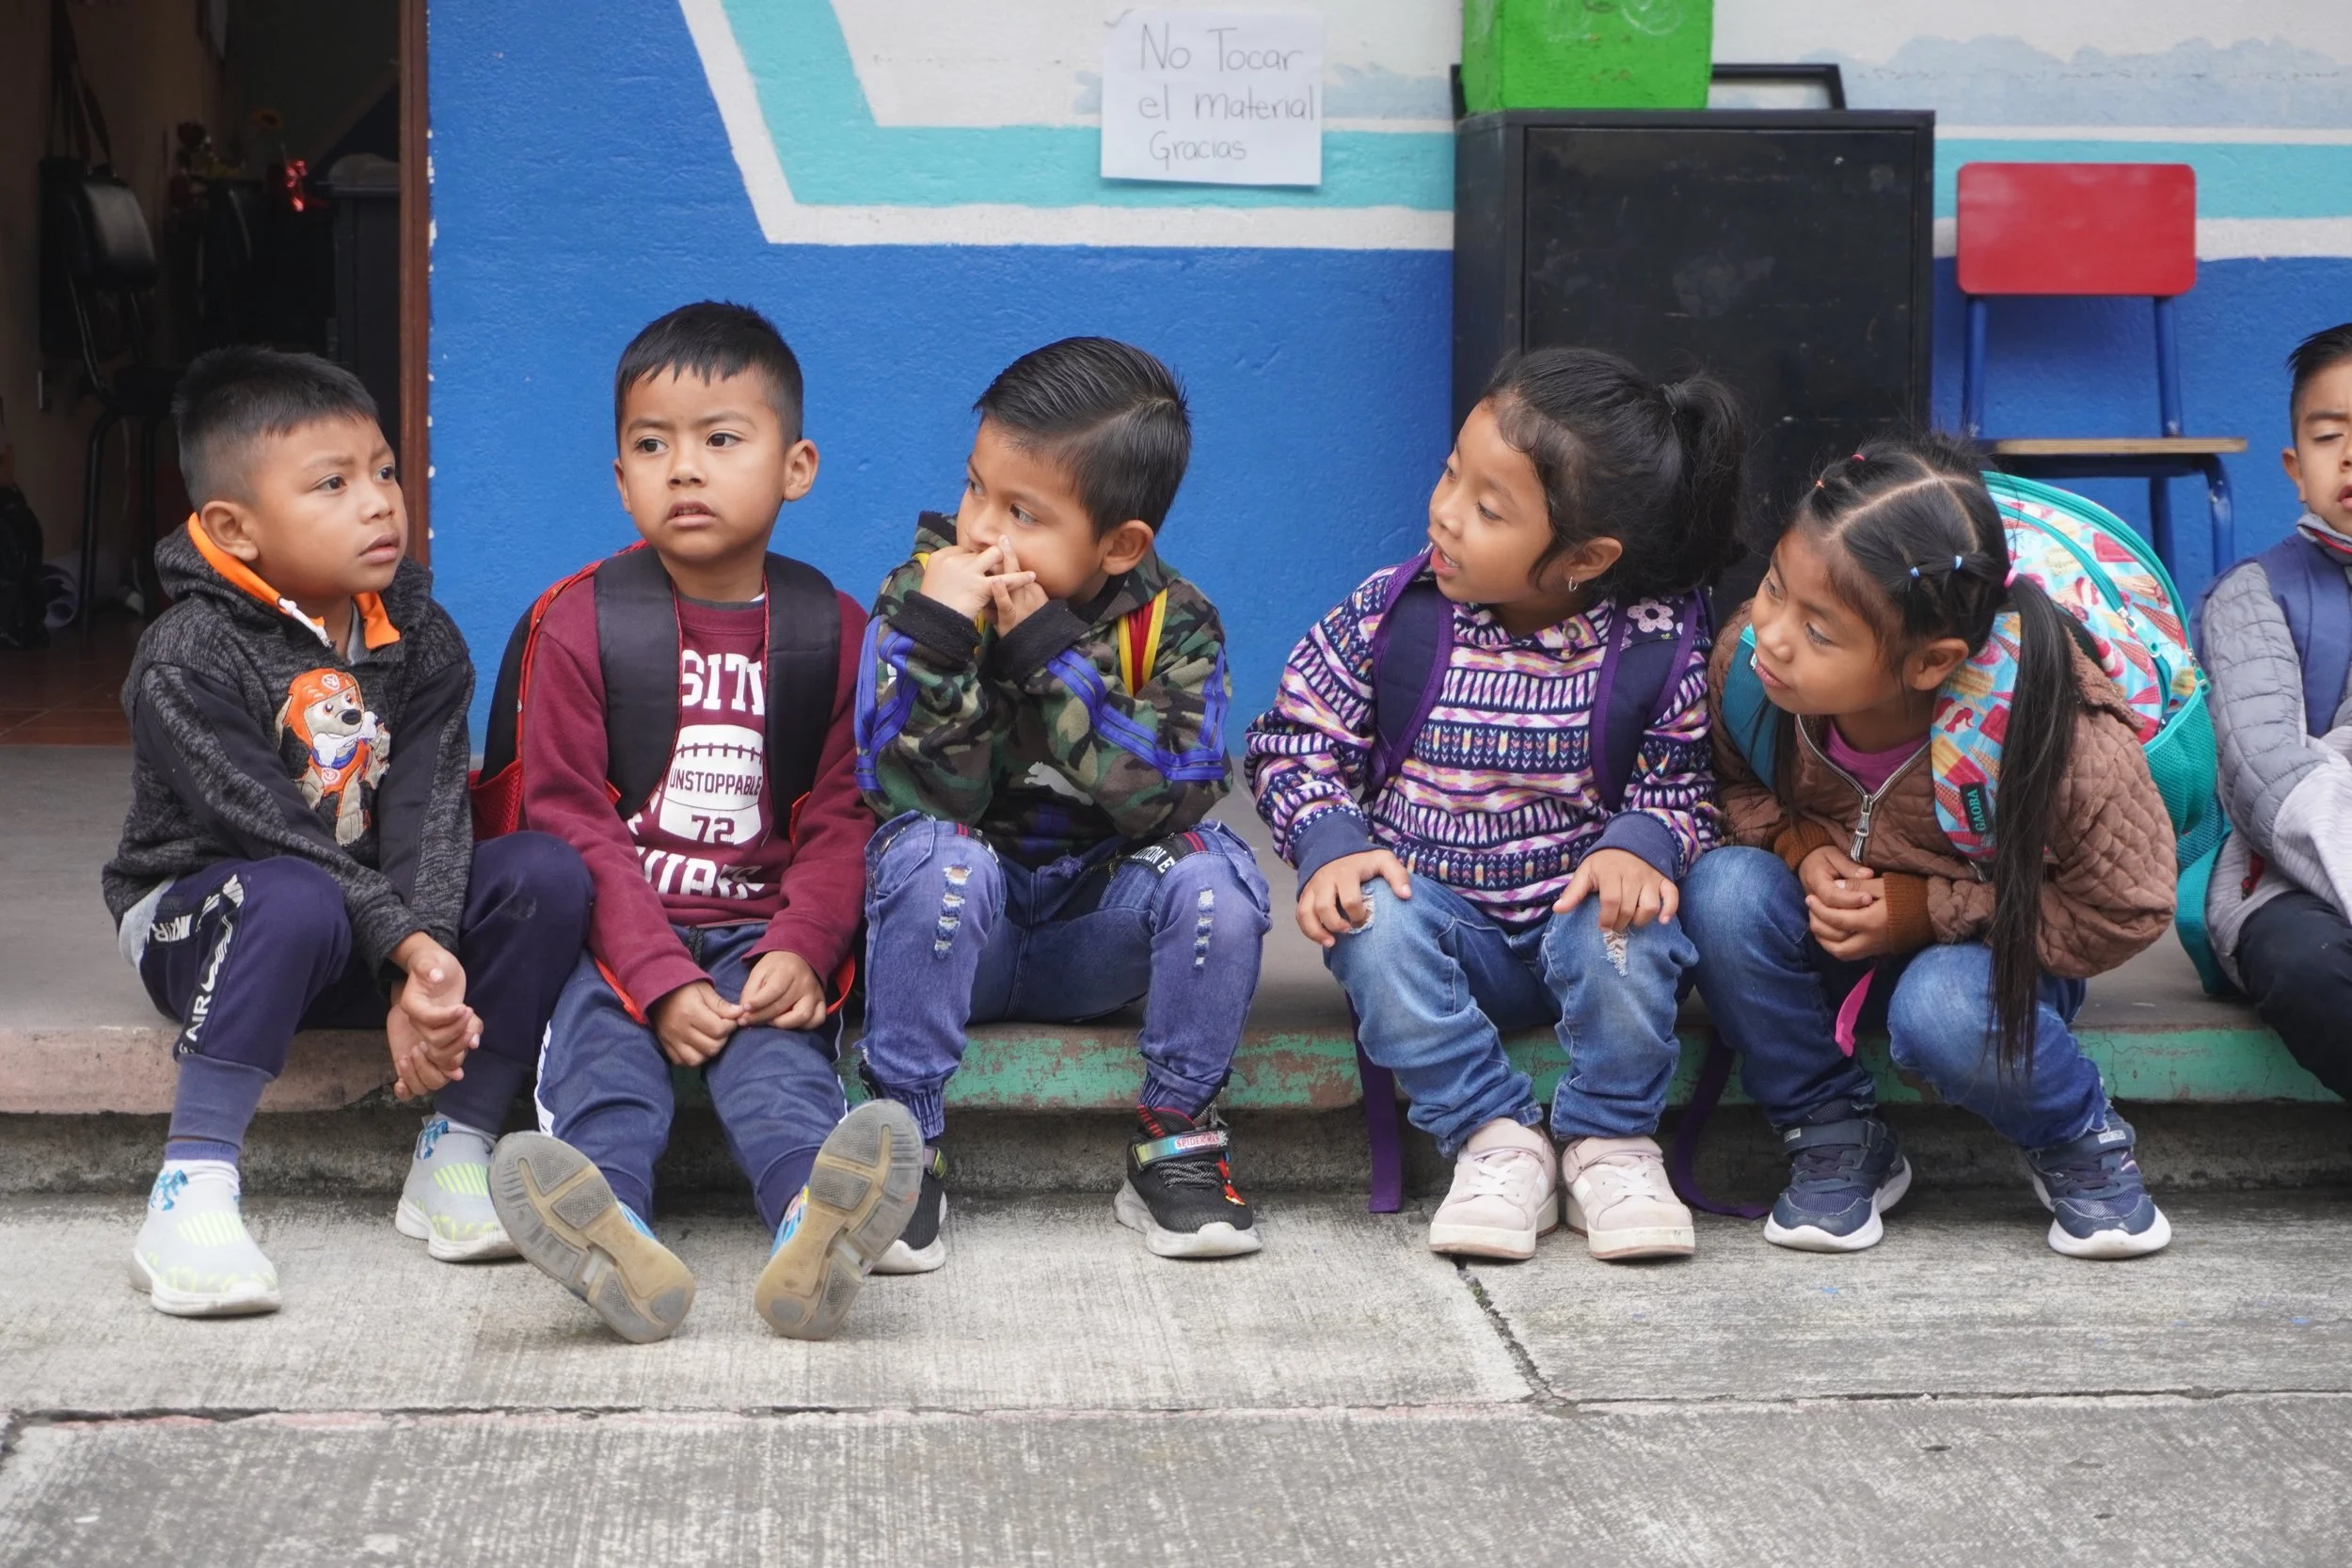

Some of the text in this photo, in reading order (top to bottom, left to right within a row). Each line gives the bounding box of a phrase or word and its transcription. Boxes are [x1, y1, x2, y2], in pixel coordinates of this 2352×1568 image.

[1140, 22, 1305, 72] No Tocar
[1137, 84, 1170, 121] el
[1149, 130, 1248, 171] Gracias
[669, 770, 763, 797] UNSTOPPABLE
[691, 815, 735, 845] 72
[1967, 788, 1987, 832] GAOBA
[186, 995, 212, 1042] AIR
